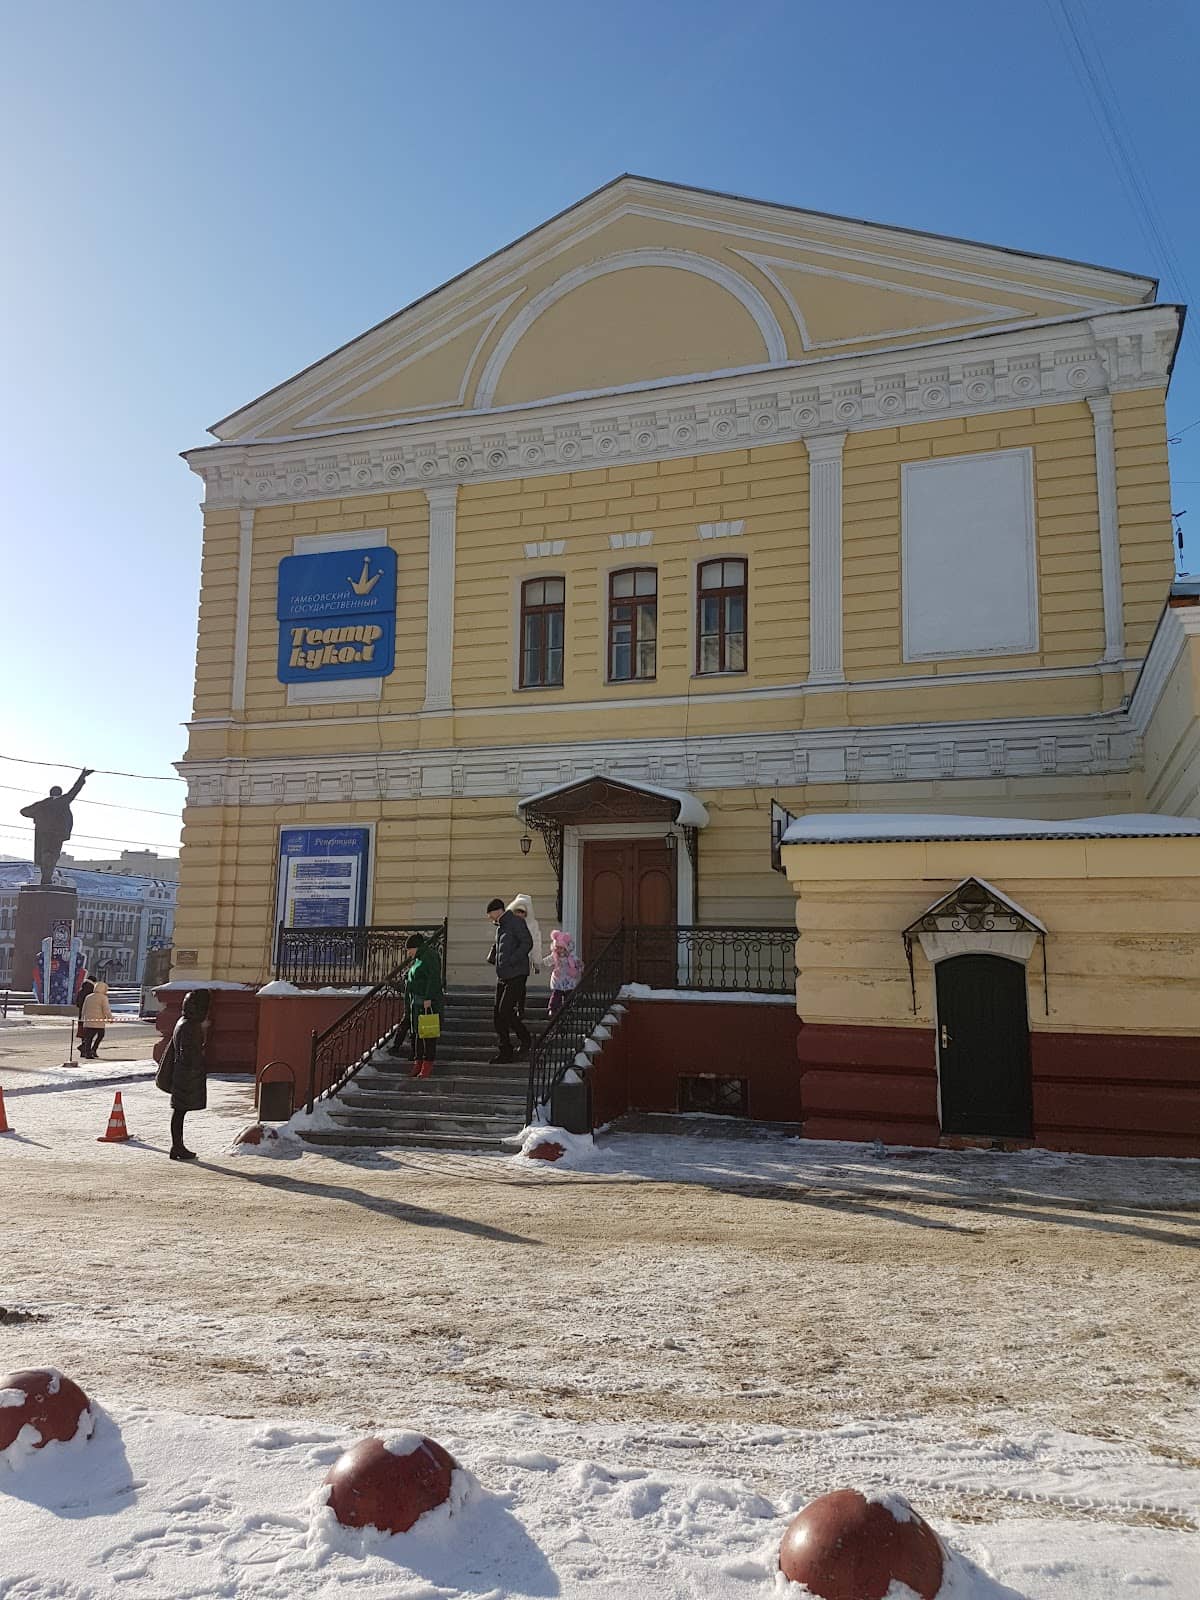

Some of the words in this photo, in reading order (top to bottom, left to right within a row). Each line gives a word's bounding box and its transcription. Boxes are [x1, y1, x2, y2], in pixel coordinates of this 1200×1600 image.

[290, 592, 350, 603] ТАМБОВСКИЙ
[290, 598, 377, 612] ГОСУДАРСТВЕННЫЙ
[290, 624, 383, 646] Театр
